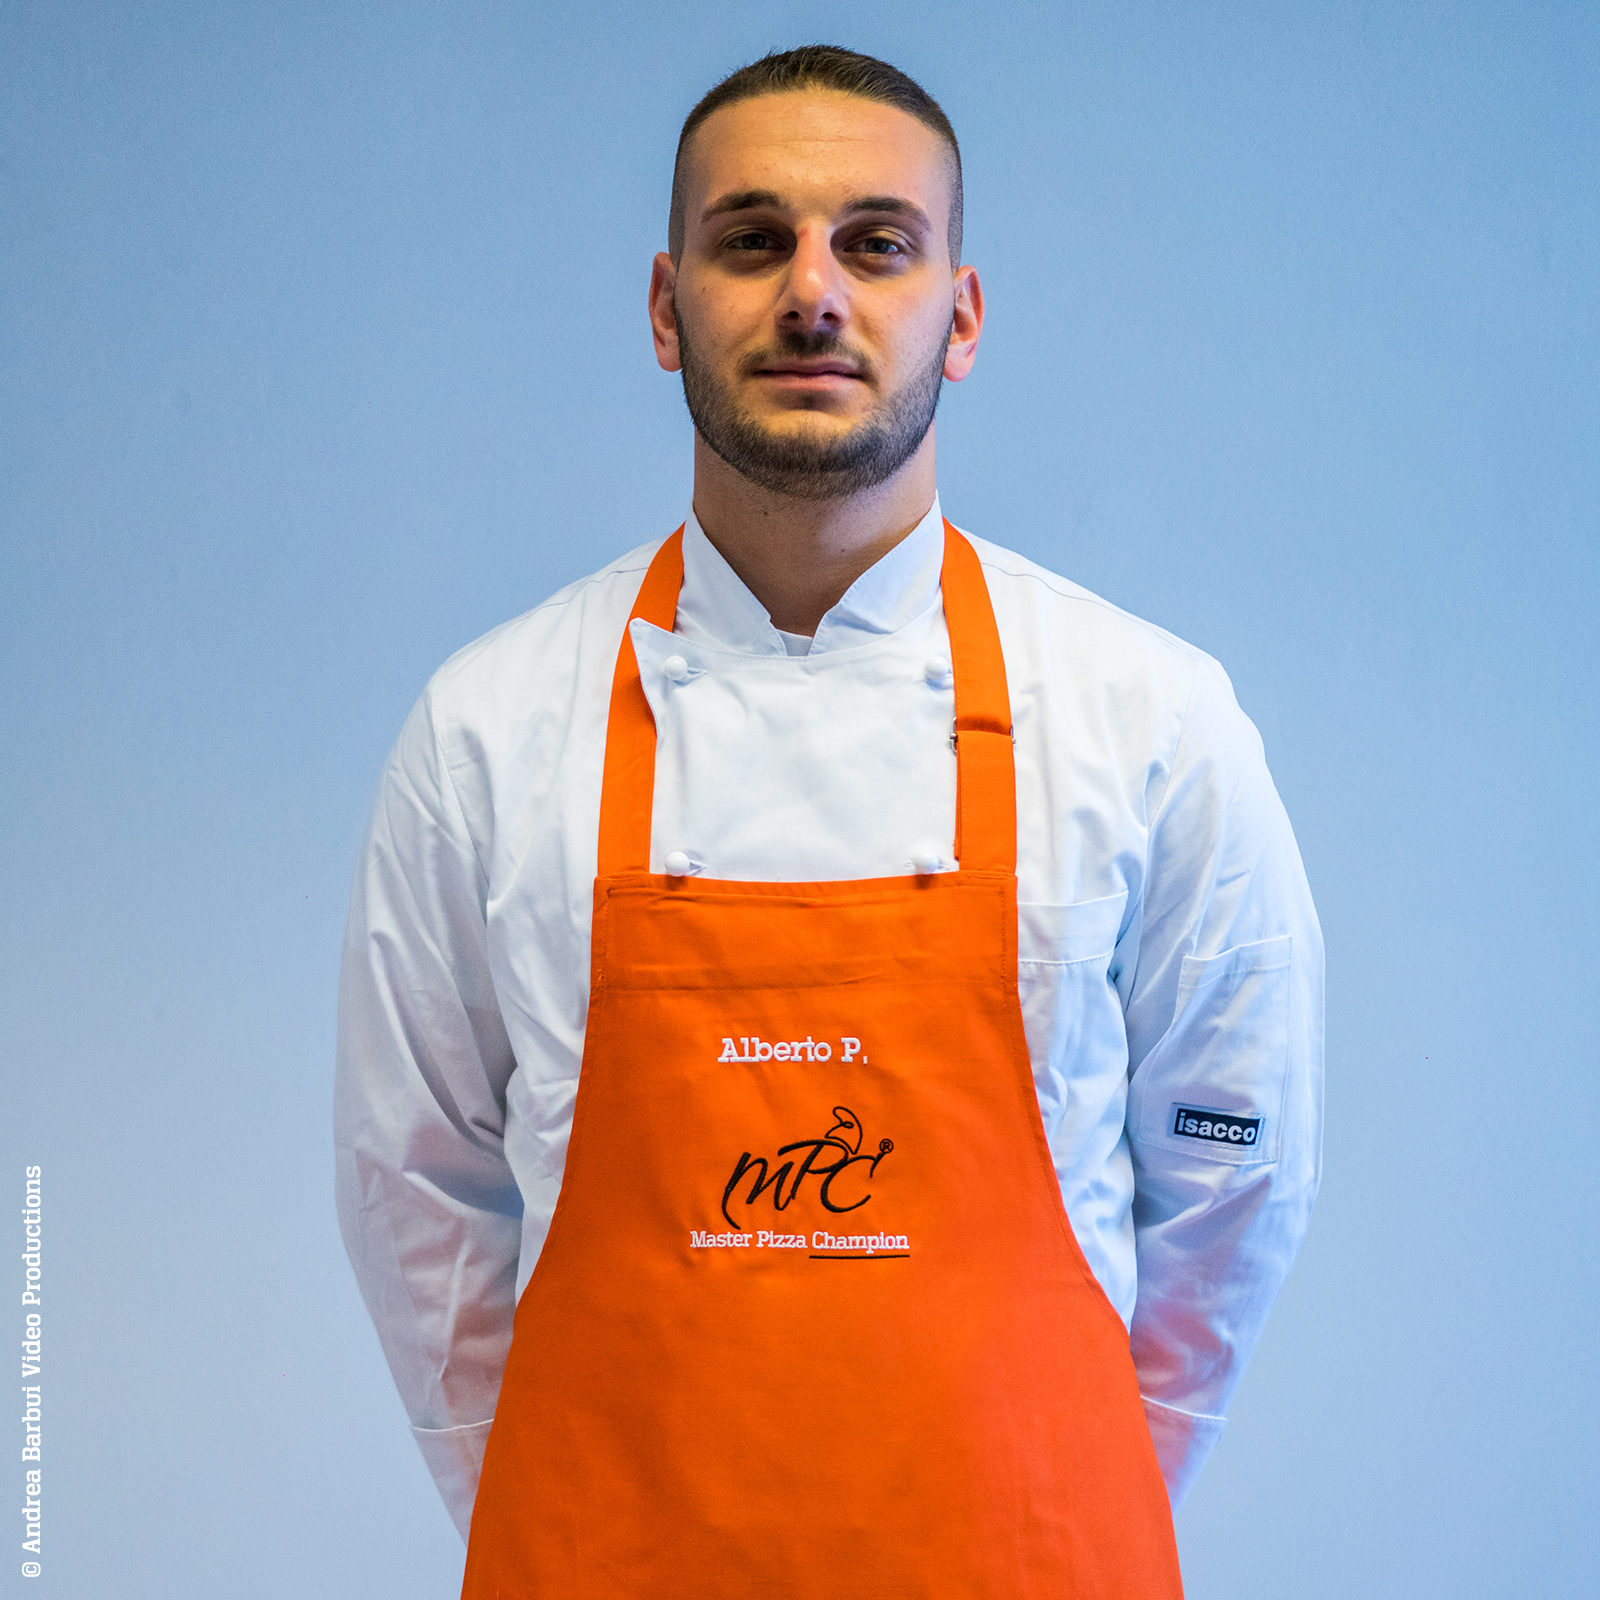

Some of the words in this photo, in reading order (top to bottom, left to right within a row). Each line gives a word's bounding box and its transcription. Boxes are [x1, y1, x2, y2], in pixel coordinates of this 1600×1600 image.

[717, 1036, 832, 1063] Alberto
[840, 1036, 868, 1064] P.
[1177, 1111, 1256, 1142] isacco
[689, 1230, 753, 1248] Master
[755, 1230, 809, 1248] Pizza
[811, 1230, 911, 1254] Champion
